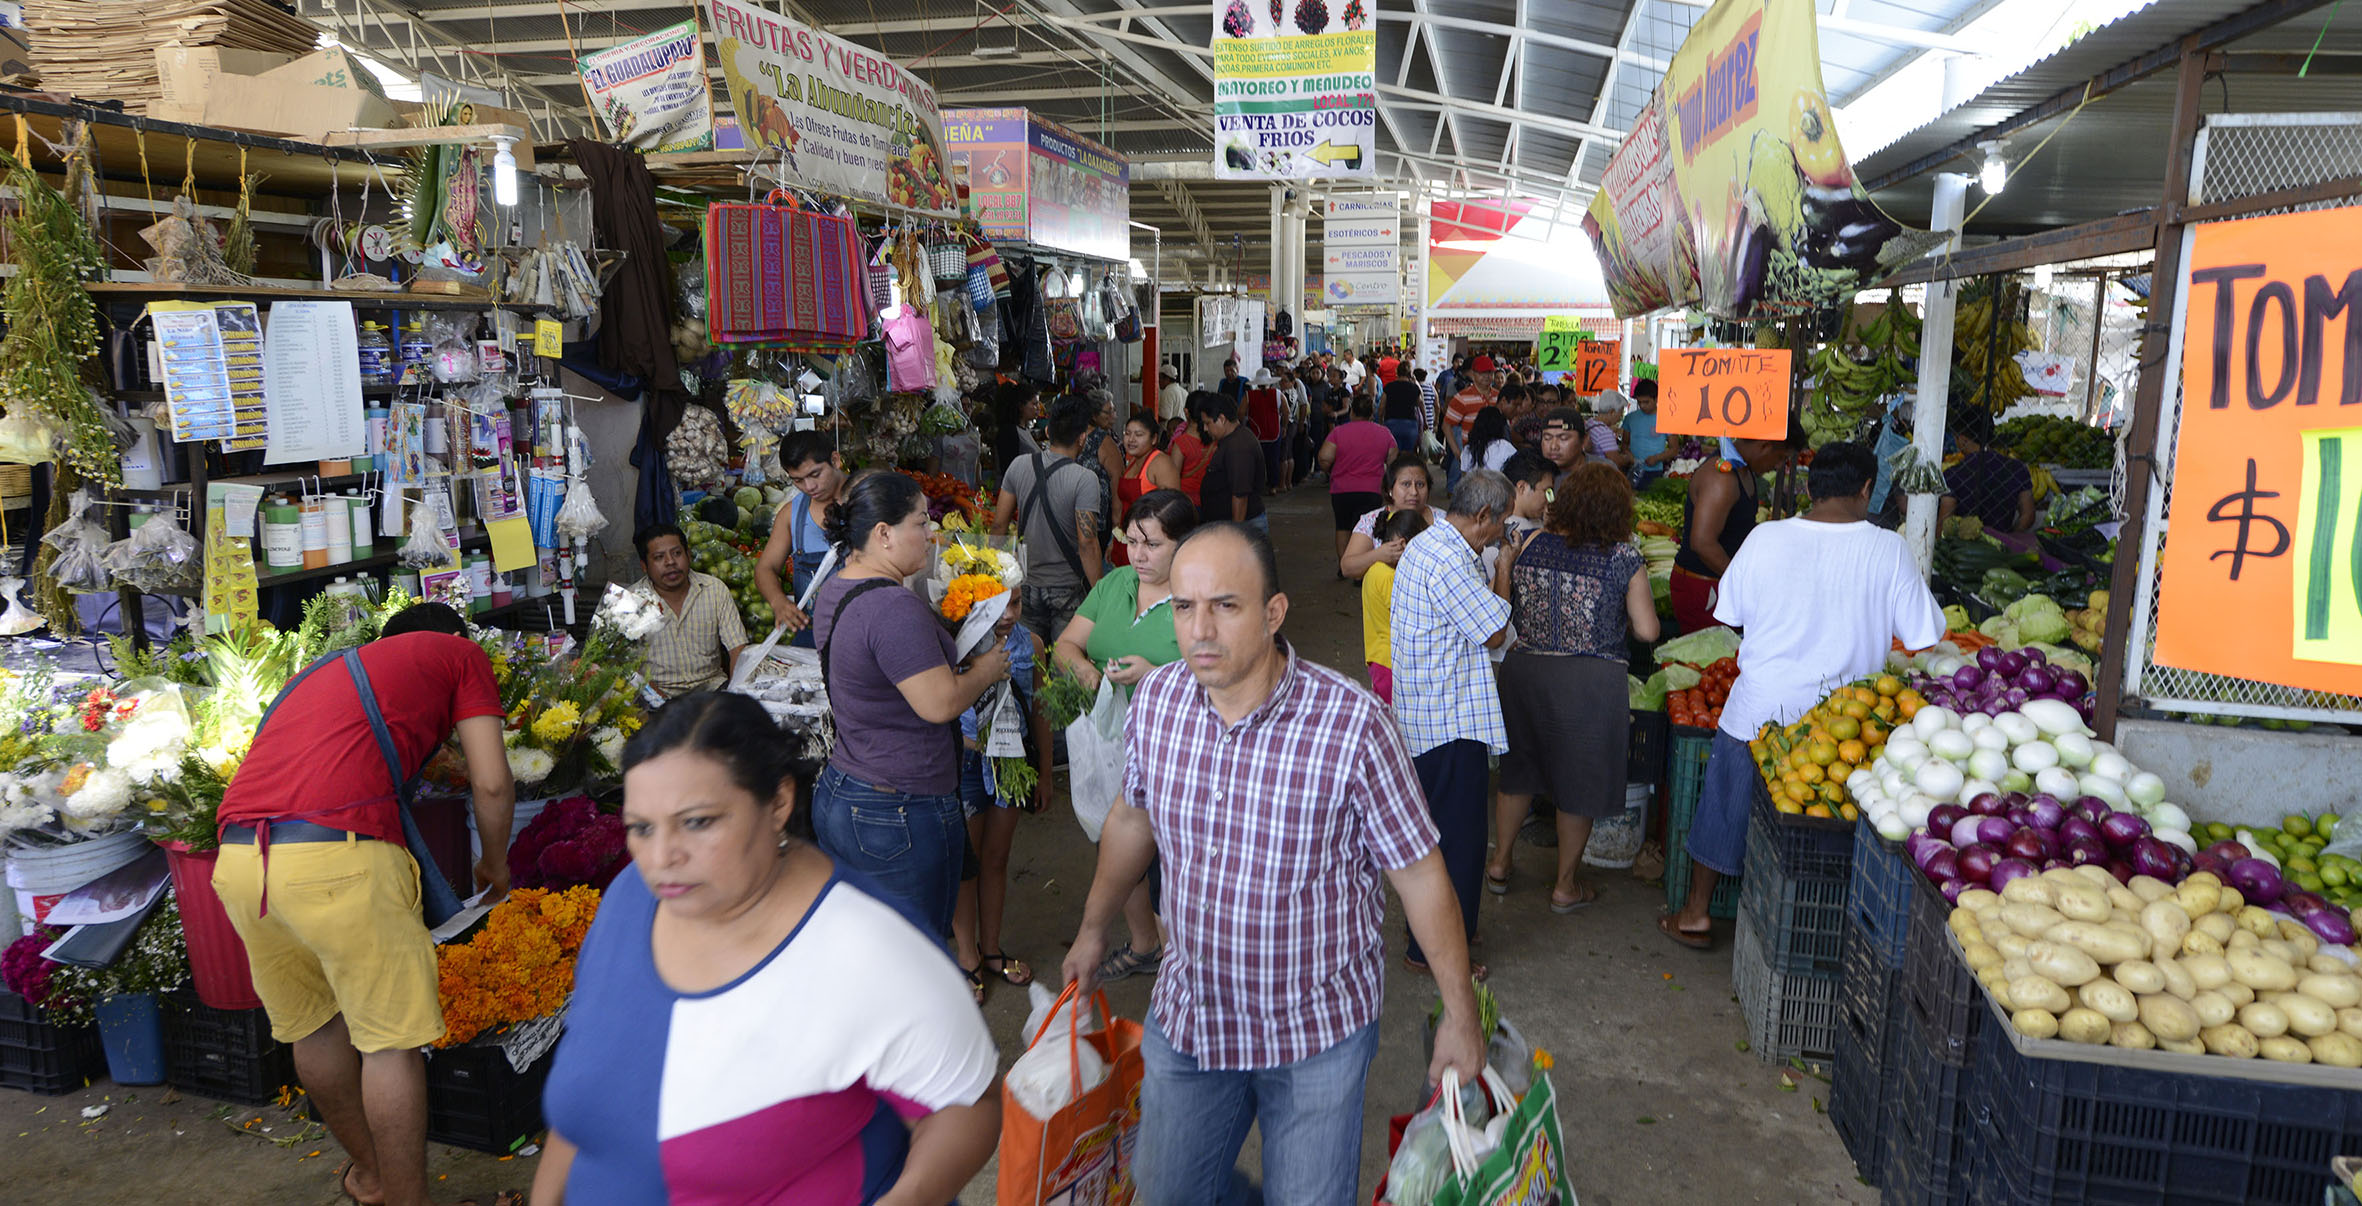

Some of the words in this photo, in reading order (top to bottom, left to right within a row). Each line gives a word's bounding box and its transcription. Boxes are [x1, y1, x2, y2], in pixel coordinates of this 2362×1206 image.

[712, 0, 813, 62] FRUTAS
[818, 38, 833, 69] Y
[1216, 44, 1248, 53] EXTENSO
[1250, 42, 1281, 52] SURTIDO
[1283, 41, 1293, 49] DE
[1295, 38, 1335, 49] ARREGLOS
[1337, 36, 1374, 46] FLORALES
[1216, 54, 1234, 63] PARA
[1235, 53, 1255, 62] TODO
[1257, 52, 1291, 61] EVENTOS
[1333, 48, 1342, 57] XV
[1218, 80, 1287, 96] MAYOREO
[1291, 79, 1299, 93] Y
[1303, 75, 1372, 92] MENUDEO
[790, 111, 804, 130] Les
[806, 118, 831, 138] Ofrece
[833, 125, 858, 146] Frutas
[859, 130, 871, 148] de
[1219, 115, 1276, 131] VENTA
[1282, 113, 1307, 129] DE
[1312, 109, 1374, 128] COCOS
[1040, 133, 1077, 159] PRODUCTOS
[1258, 130, 1315, 147] FRIOS
[803, 140, 834, 161] Calidad
[835, 150, 842, 165] y
[843, 149, 866, 168] buen
[978, 195, 1003, 208] LOCAL
[1005, 194, 1022, 208] 887
[1328, 229, 1379, 238] ESOTÉRICOS
[1341, 250, 1386, 259] PESCADOS
[1386, 250, 1392, 259] Y
[1345, 260, 1388, 268] MARISCOS
[1583, 341, 1615, 355] TOMATE
[1681, 351, 1778, 376] TOMATE
[1583, 358, 1607, 393] 12
[1696, 384, 1752, 426] 10
[2206, 458, 2291, 581] $
[2305, 437, 2362, 640] 1
